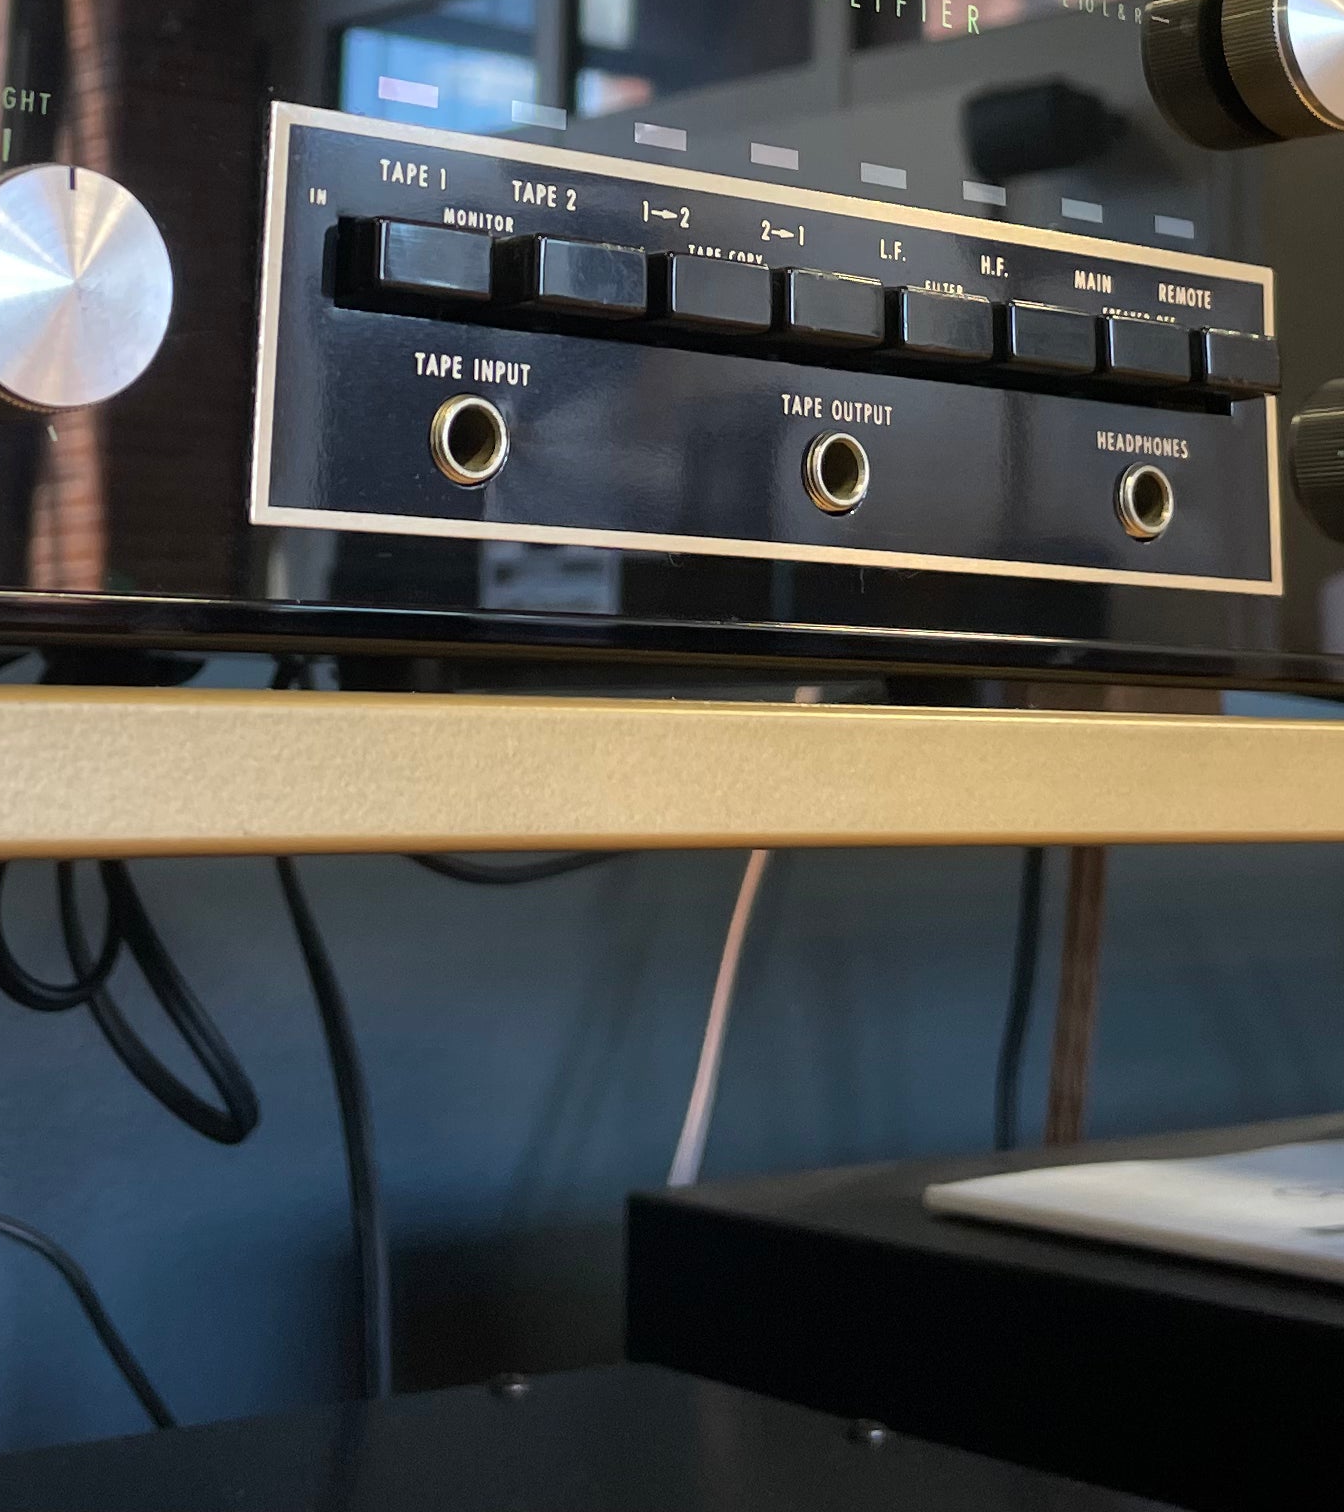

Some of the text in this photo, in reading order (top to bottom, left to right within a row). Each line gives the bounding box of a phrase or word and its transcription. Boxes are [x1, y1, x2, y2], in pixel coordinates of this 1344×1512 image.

[1134, 7, 1142, 25] R
[380, 159, 428, 188] TAPE
[309, 188, 326, 206] IN
[512, 179, 577, 212] TAPE 2
[444, 207, 514, 234] MONITOR
[880, 238, 906, 262] L.F.
[980, 254, 1009, 278] H.F.
[1074, 270, 1112, 294] MAIN
[1158, 282, 1212, 310] REMOTE
[415, 352, 531, 387] TAPE INPUT
[782, 394, 893, 426] TAPE OUTPUT
[1096, 430, 1189, 460] HEADPHONES
